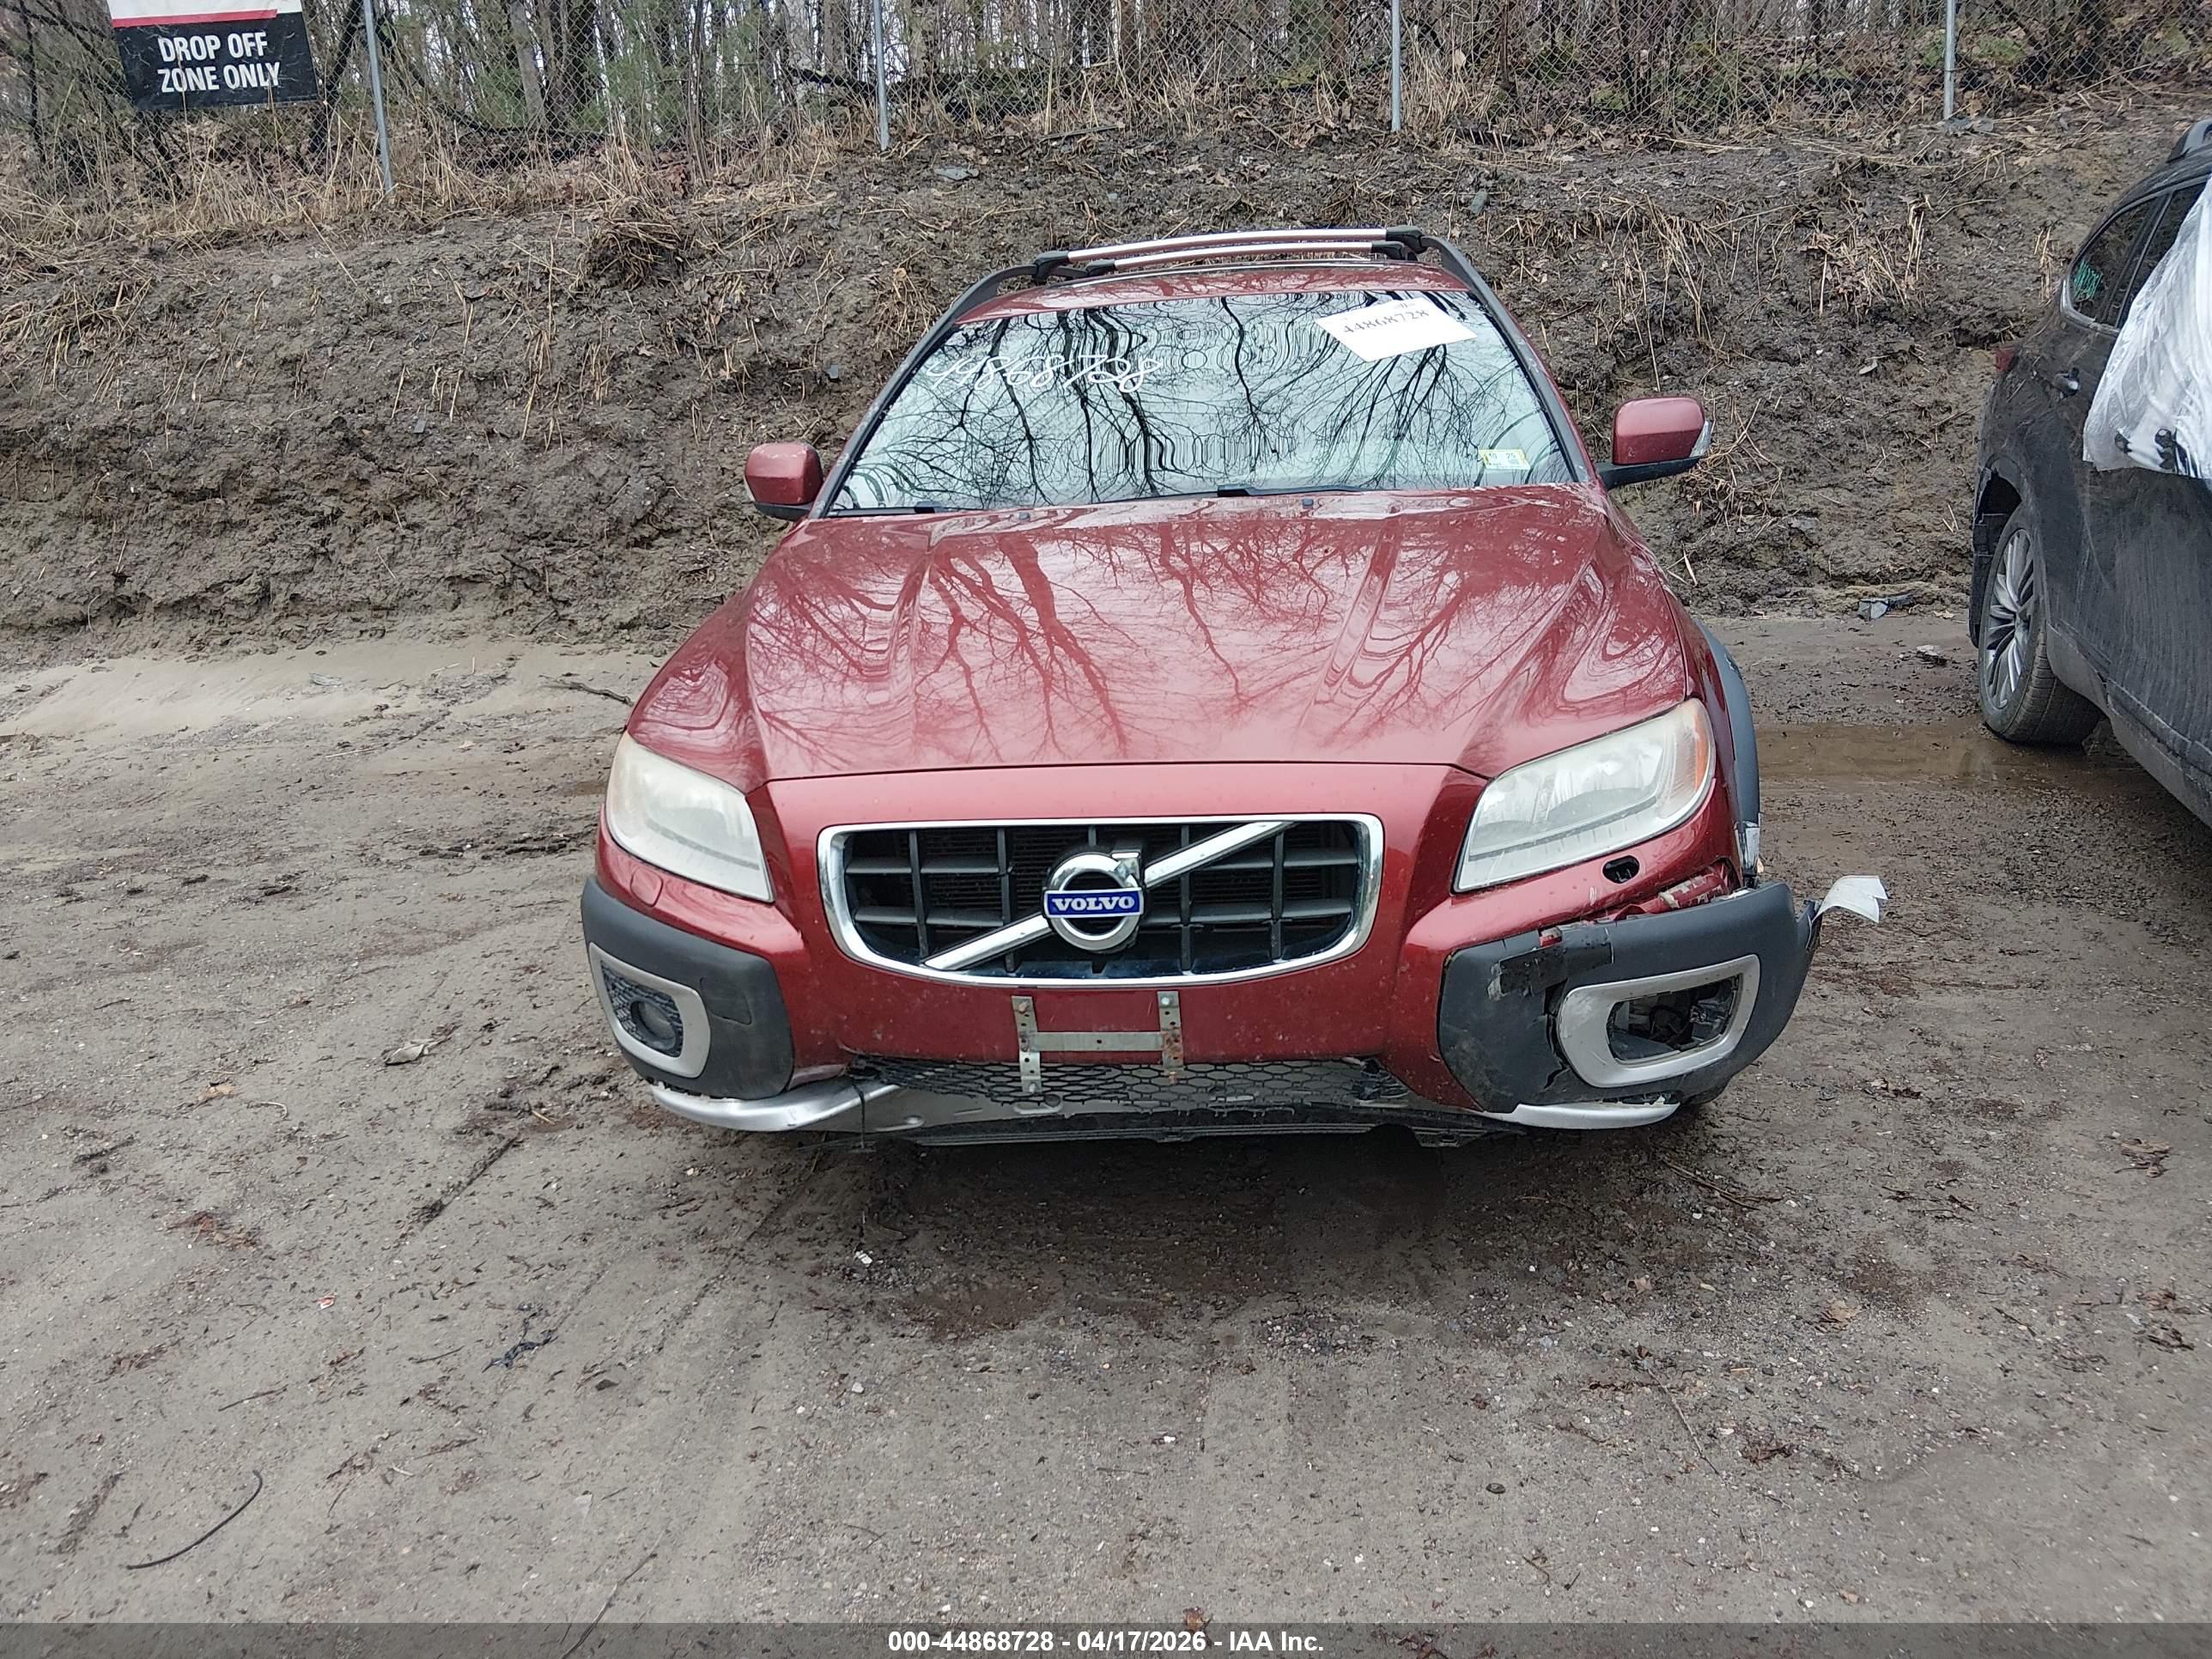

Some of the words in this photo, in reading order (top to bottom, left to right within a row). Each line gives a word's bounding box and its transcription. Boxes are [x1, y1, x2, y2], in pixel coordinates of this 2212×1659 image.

[158, 34, 221, 63] DROP
[228, 32, 268, 59] OFF
[158, 66, 220, 94] ZONE
[224, 62, 280, 90] ONLY
[1052, 896, 1135, 912] VOLVO
